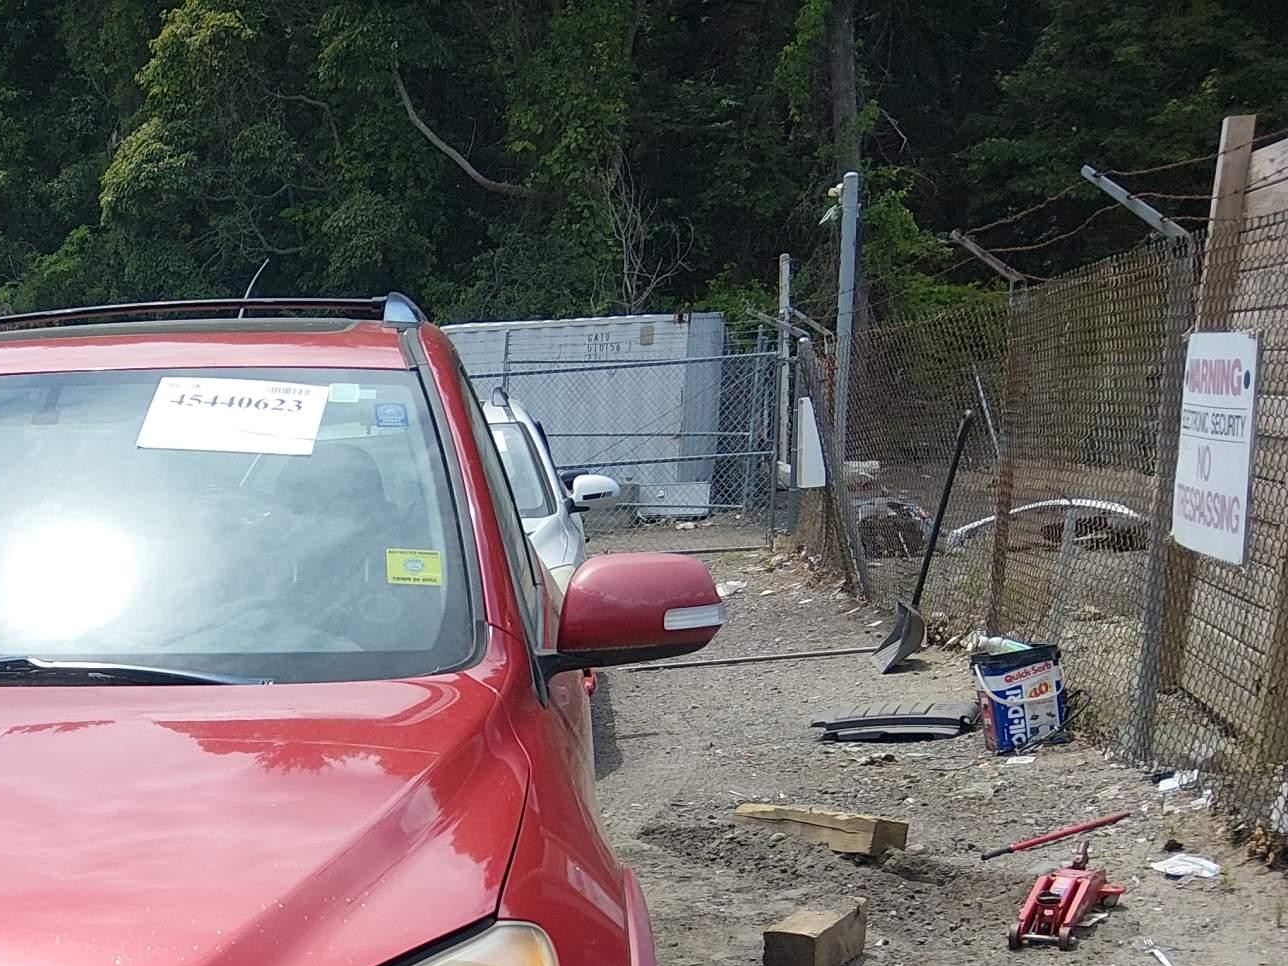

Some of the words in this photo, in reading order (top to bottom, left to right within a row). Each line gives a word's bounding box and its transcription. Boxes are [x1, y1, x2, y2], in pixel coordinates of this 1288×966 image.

[1188, 357, 1243, 397] WARNING
[170, 392, 303, 413] 45440623
[1211, 411, 1247, 438] SECURITY
[1195, 443, 1212, 482] NO
[1176, 483, 1241, 534] TRESPASSING
[1003, 668, 1032, 684] Quick
[1032, 661, 1052, 676] Sorb
